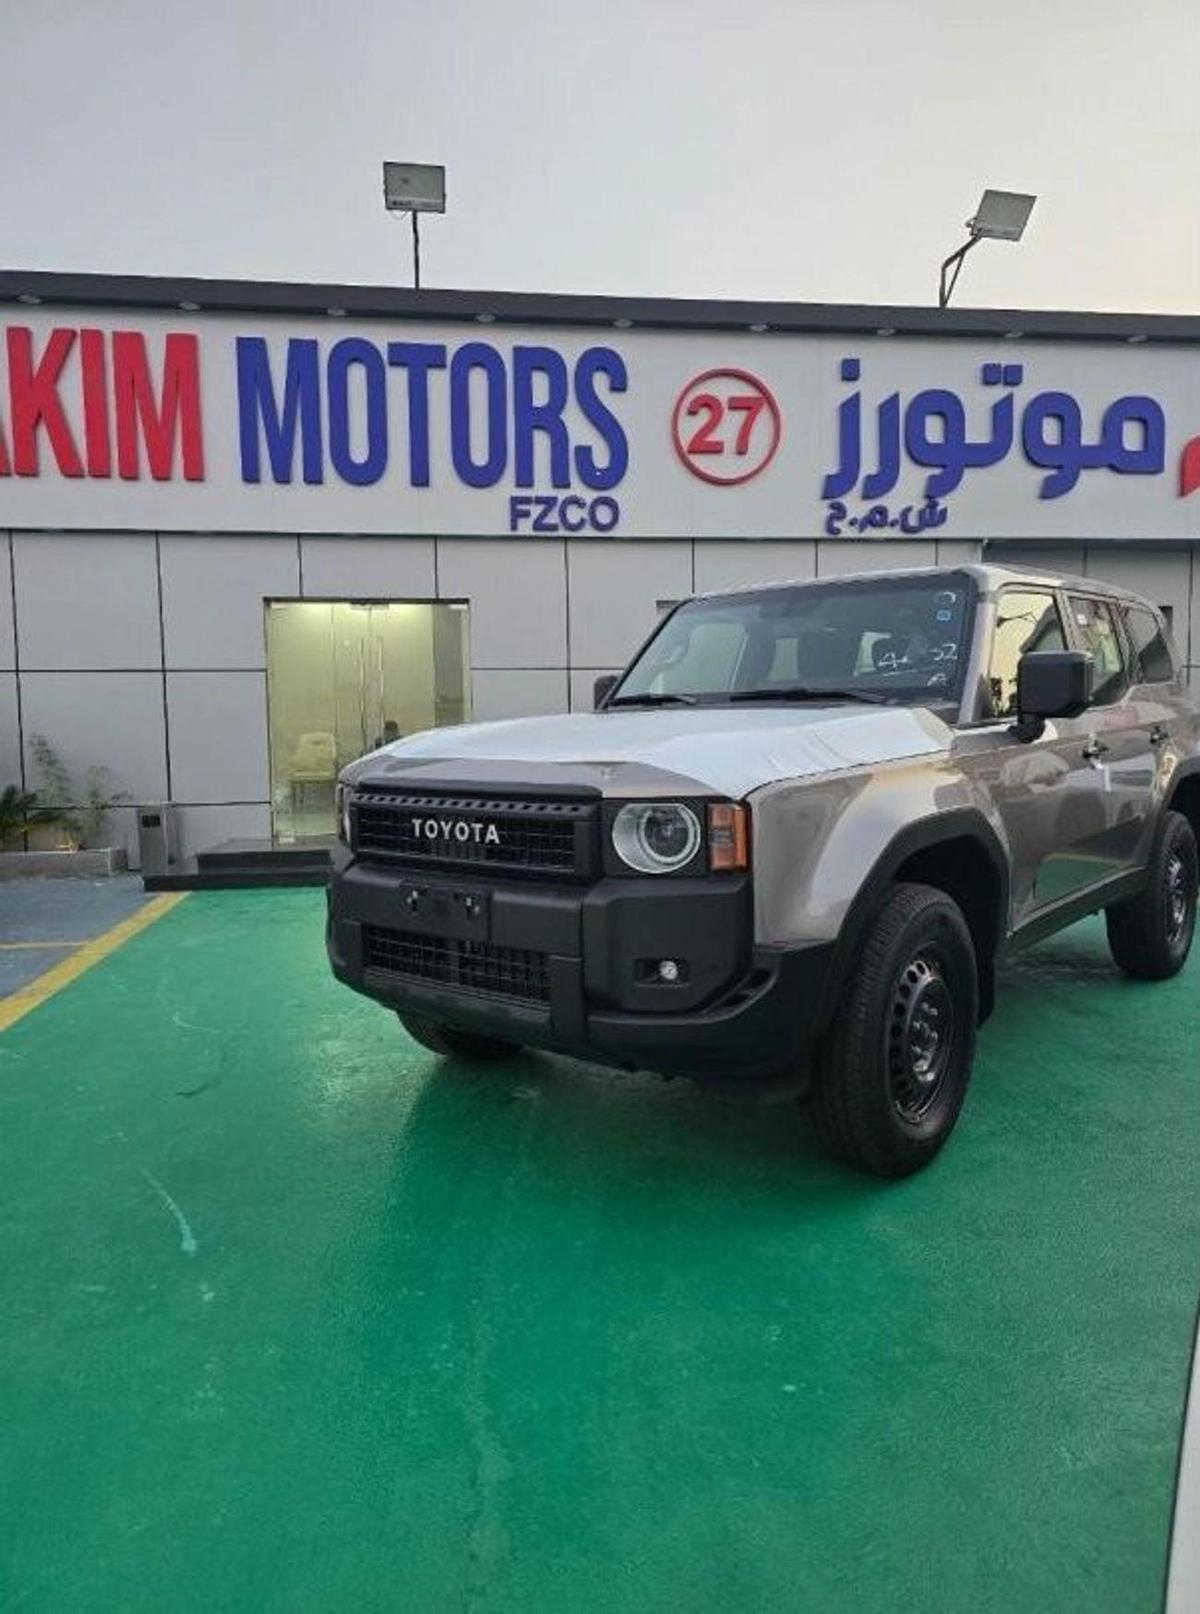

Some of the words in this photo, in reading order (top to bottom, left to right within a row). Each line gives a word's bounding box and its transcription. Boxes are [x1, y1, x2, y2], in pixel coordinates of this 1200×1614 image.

[0, 326, 205, 481] KIM
[236, 336, 629, 490] MOTORS
[686, 393, 766, 456] 27
[821, 358, 1165, 500] موتورز
[510, 496, 620, 532] FZCO
[411, 818, 500, 844] TOYOTA
